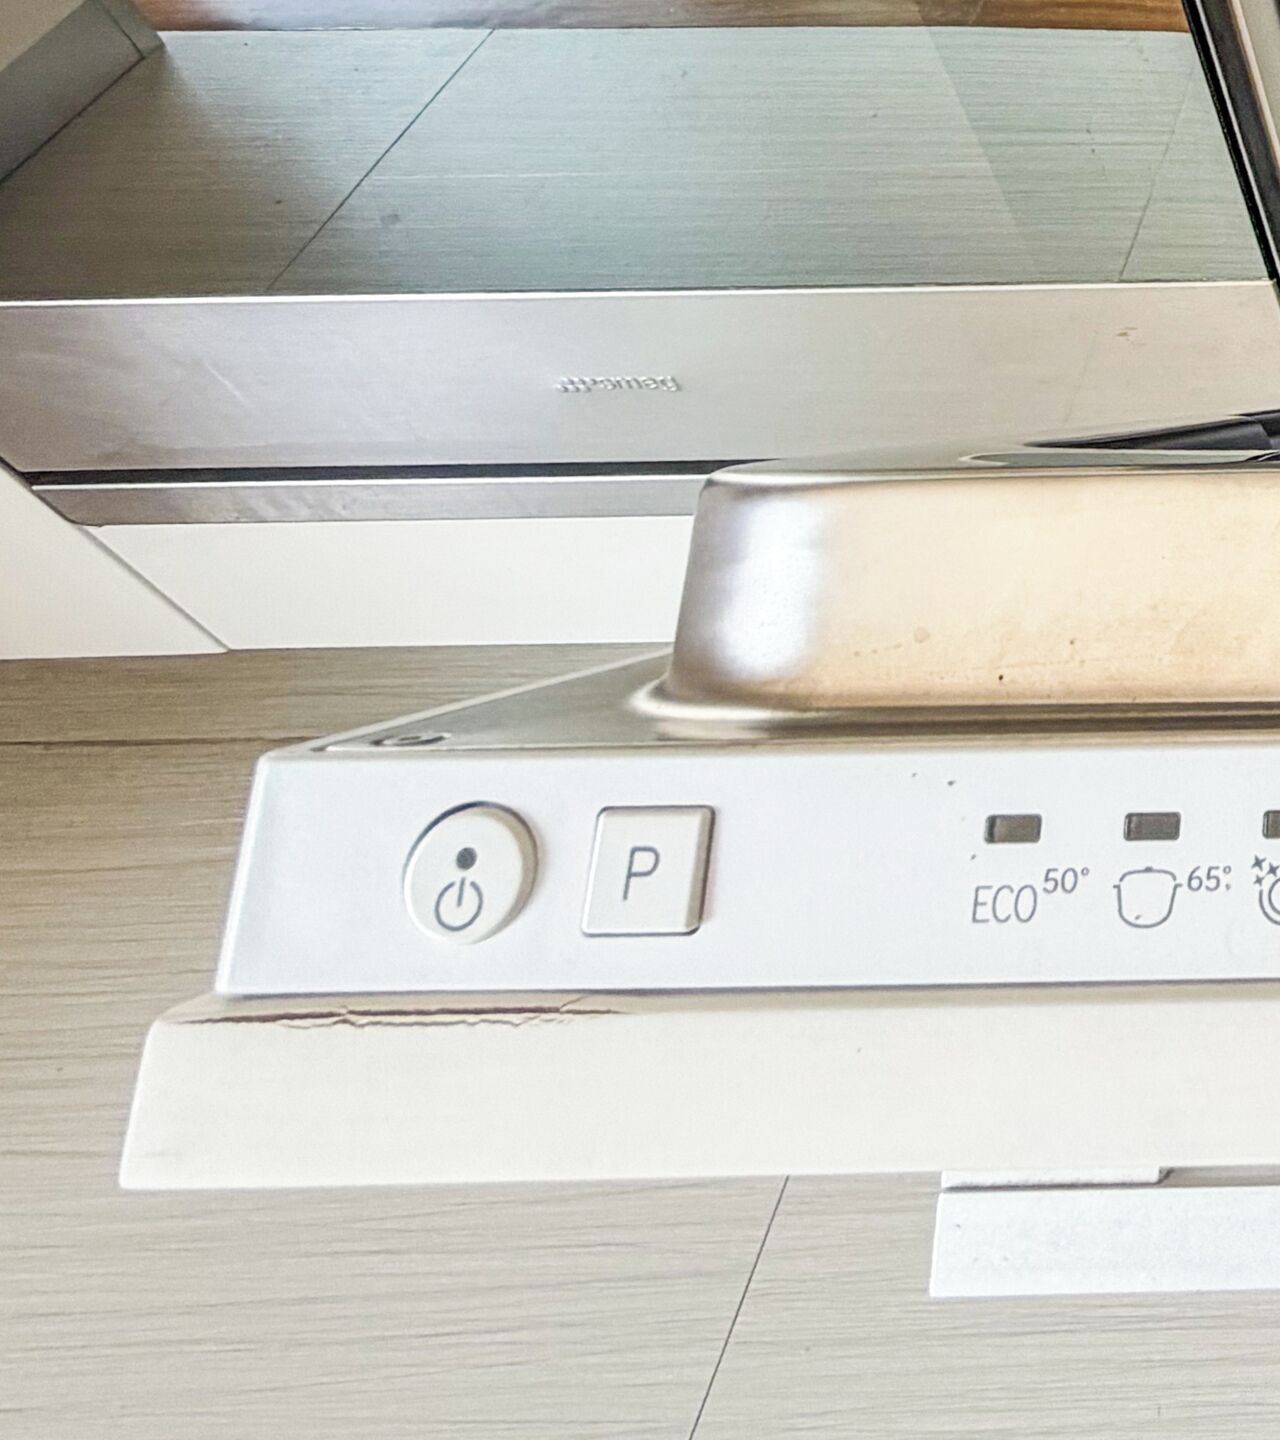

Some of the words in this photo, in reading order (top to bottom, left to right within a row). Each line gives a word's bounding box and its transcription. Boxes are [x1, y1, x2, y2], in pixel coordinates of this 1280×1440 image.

[622, 846, 661, 902] P
[972, 884, 1039, 924] ECO
[1043, 866, 1090, 895] 50°
